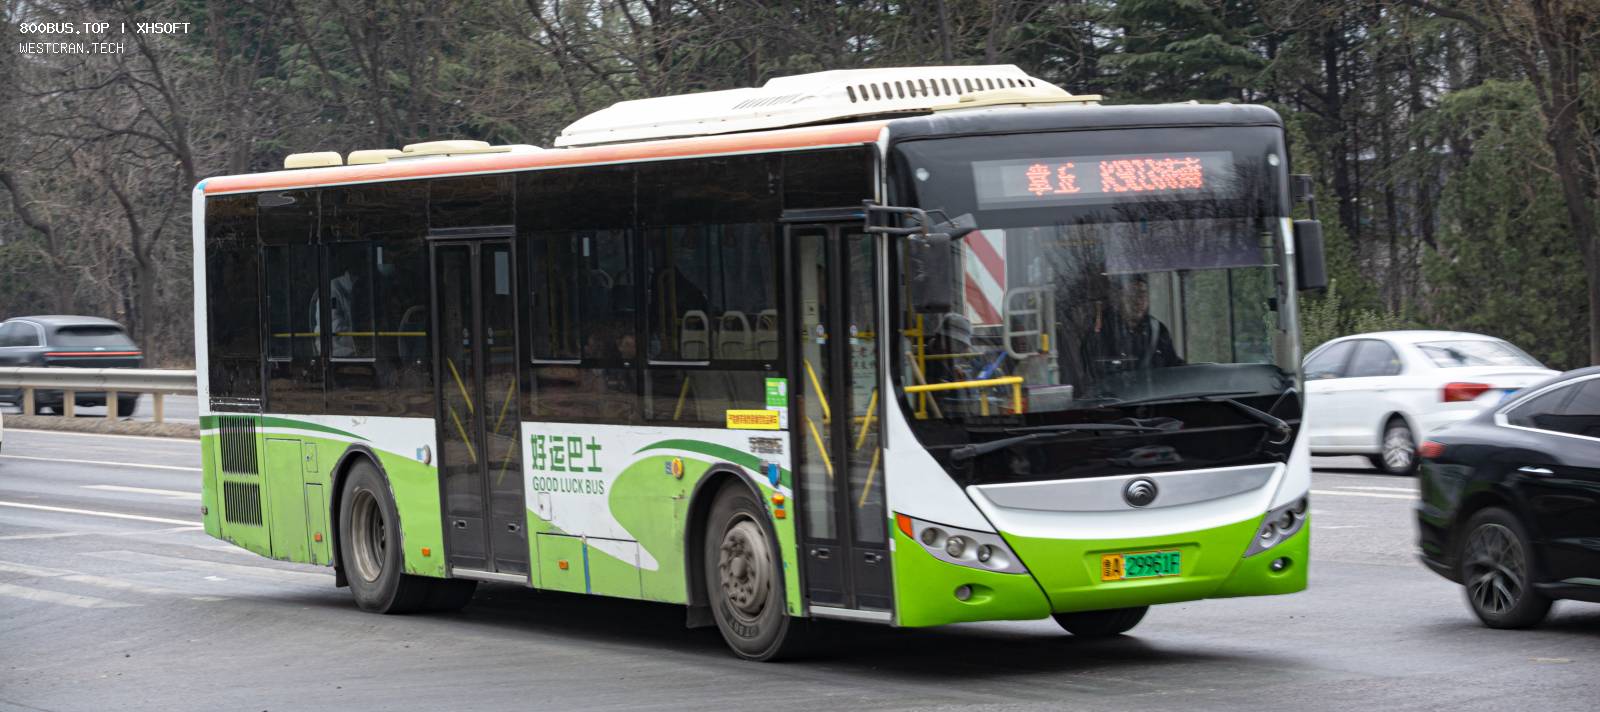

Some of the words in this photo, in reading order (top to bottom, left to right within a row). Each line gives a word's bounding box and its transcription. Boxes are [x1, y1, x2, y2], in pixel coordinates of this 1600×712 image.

[1025, 162, 1081, 197] 章丘
[530, 434, 603, 473] 好运巴士
[532, 476, 559, 492] GOOD
[560, 478, 585, 494] LUCK
[585, 479, 605, 495] BUS
